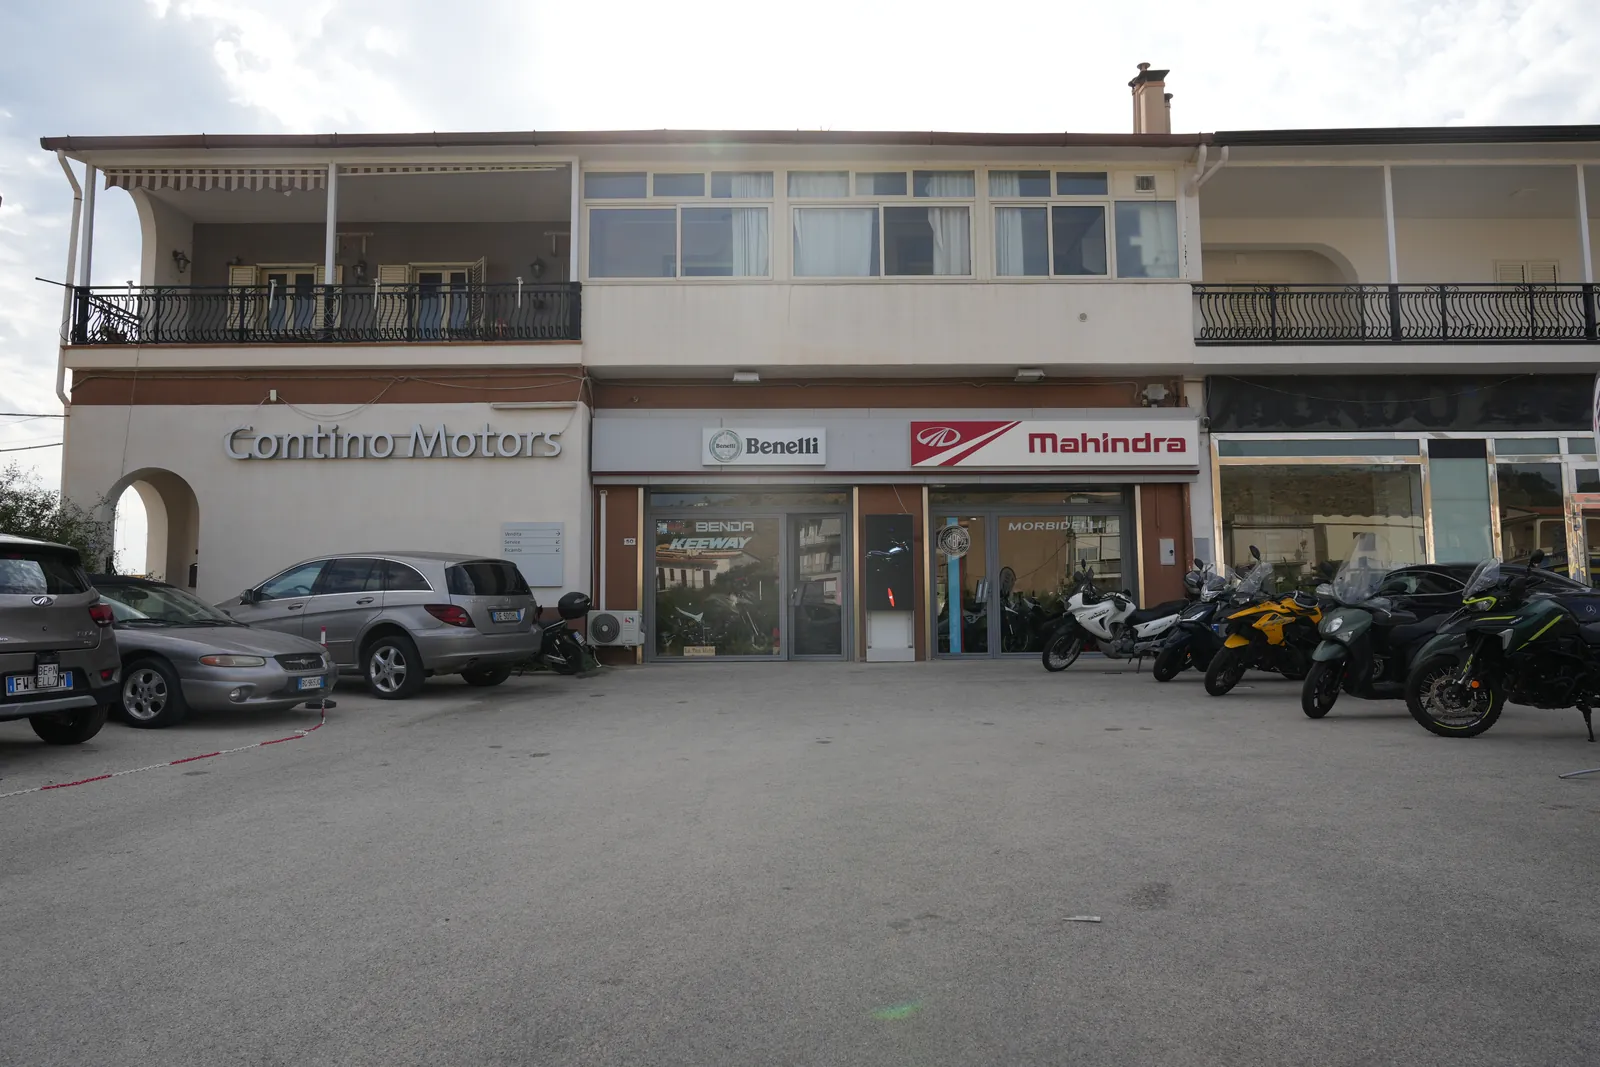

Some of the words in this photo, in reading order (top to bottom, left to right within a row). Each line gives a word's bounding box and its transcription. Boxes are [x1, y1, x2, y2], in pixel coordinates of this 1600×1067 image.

[224, 423, 395, 460] Contino
[407, 422, 563, 459] Motors
[746, 437, 819, 455] Benelli
[1028, 432, 1187, 454] Mahindra
[695, 521, 755, 532] BENDA
[1008, 520, 1102, 532] MORBIDELLI
[669, 536, 753, 550] KEEWAY
